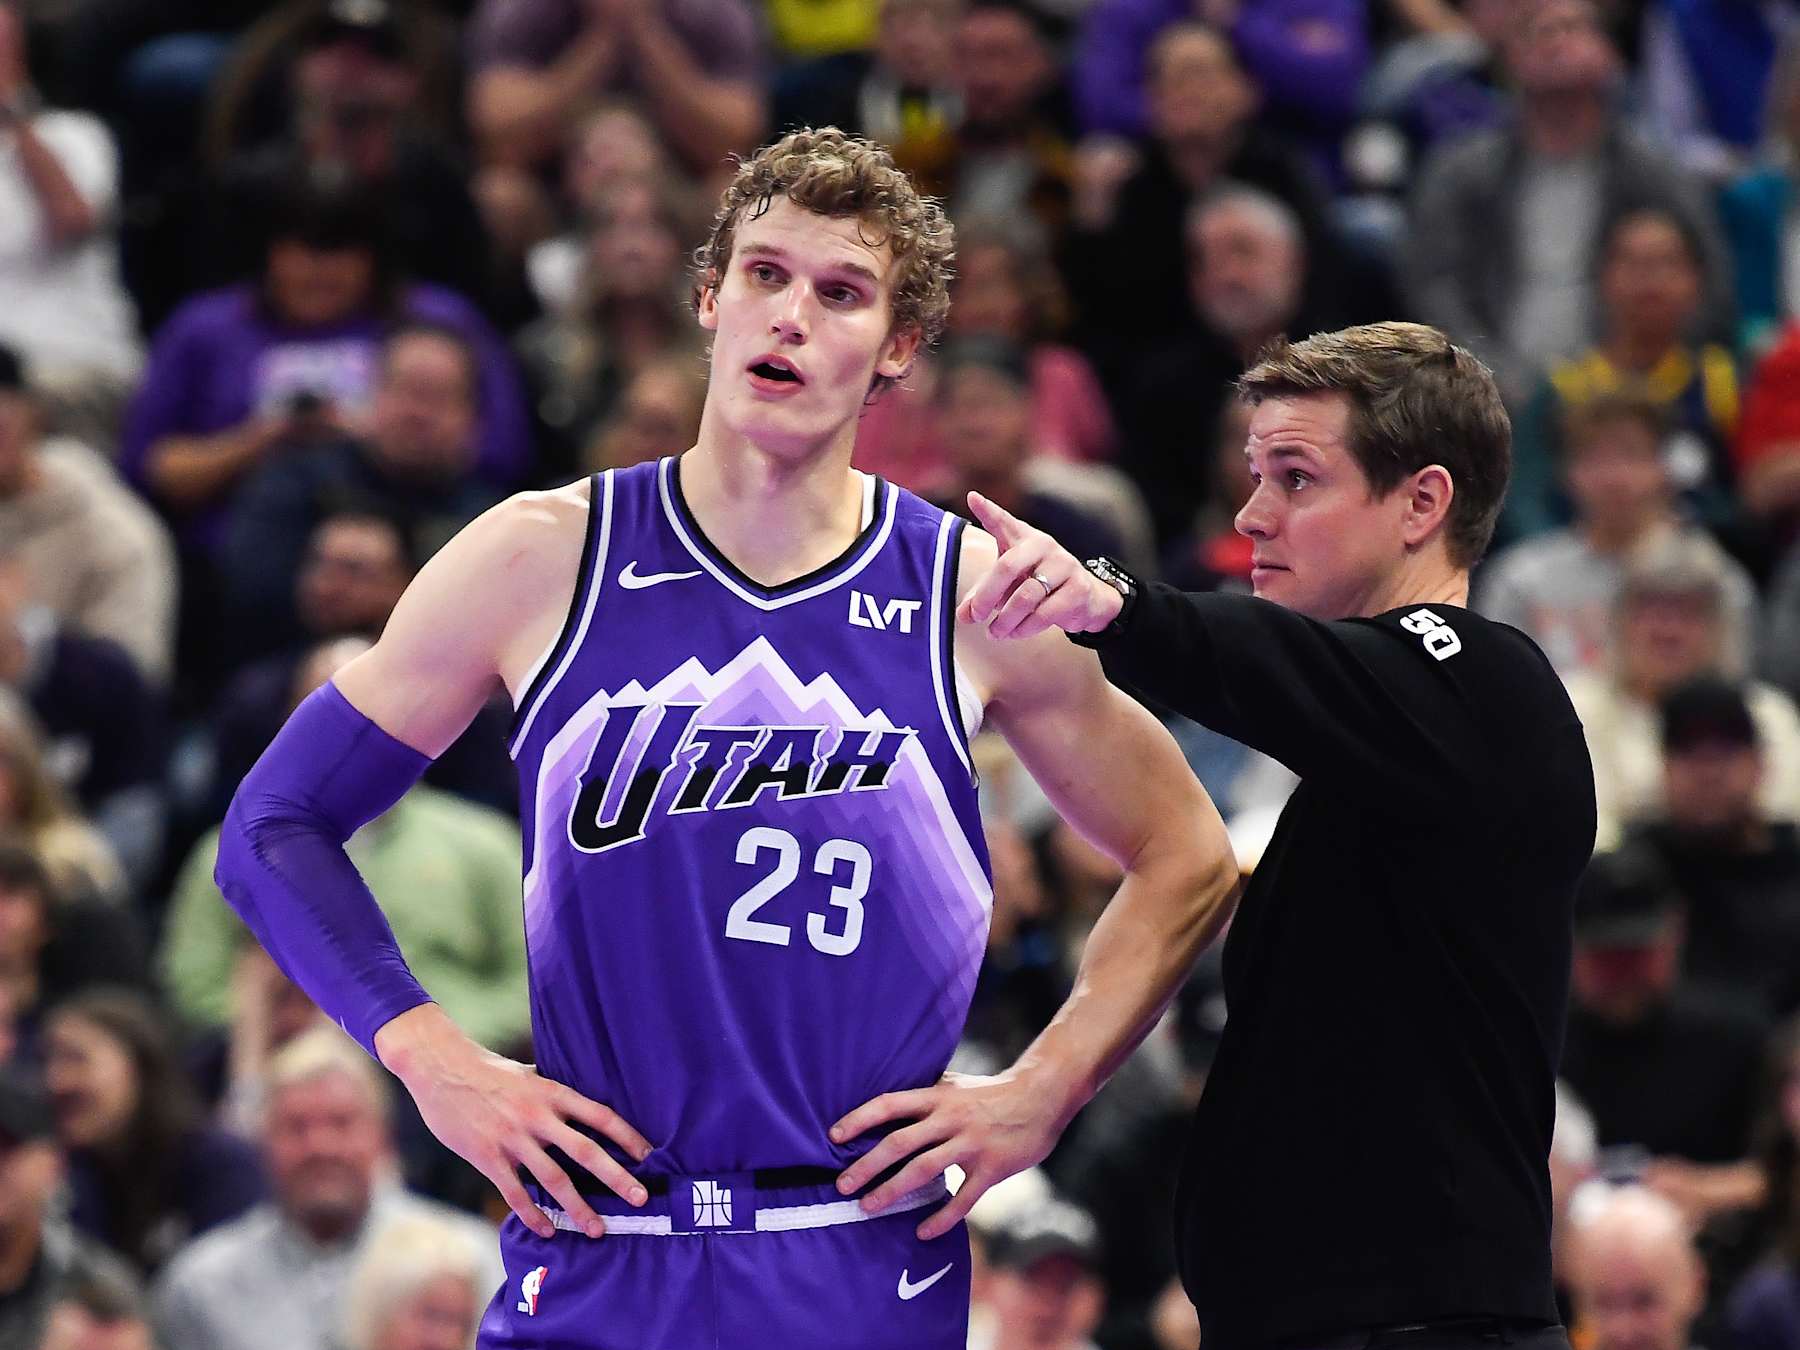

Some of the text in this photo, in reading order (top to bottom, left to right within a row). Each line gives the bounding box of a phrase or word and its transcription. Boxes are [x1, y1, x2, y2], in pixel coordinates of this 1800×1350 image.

[848, 590, 922, 634] LVT
[1400, 608, 1462, 661] 50
[725, 827, 873, 956] 23
